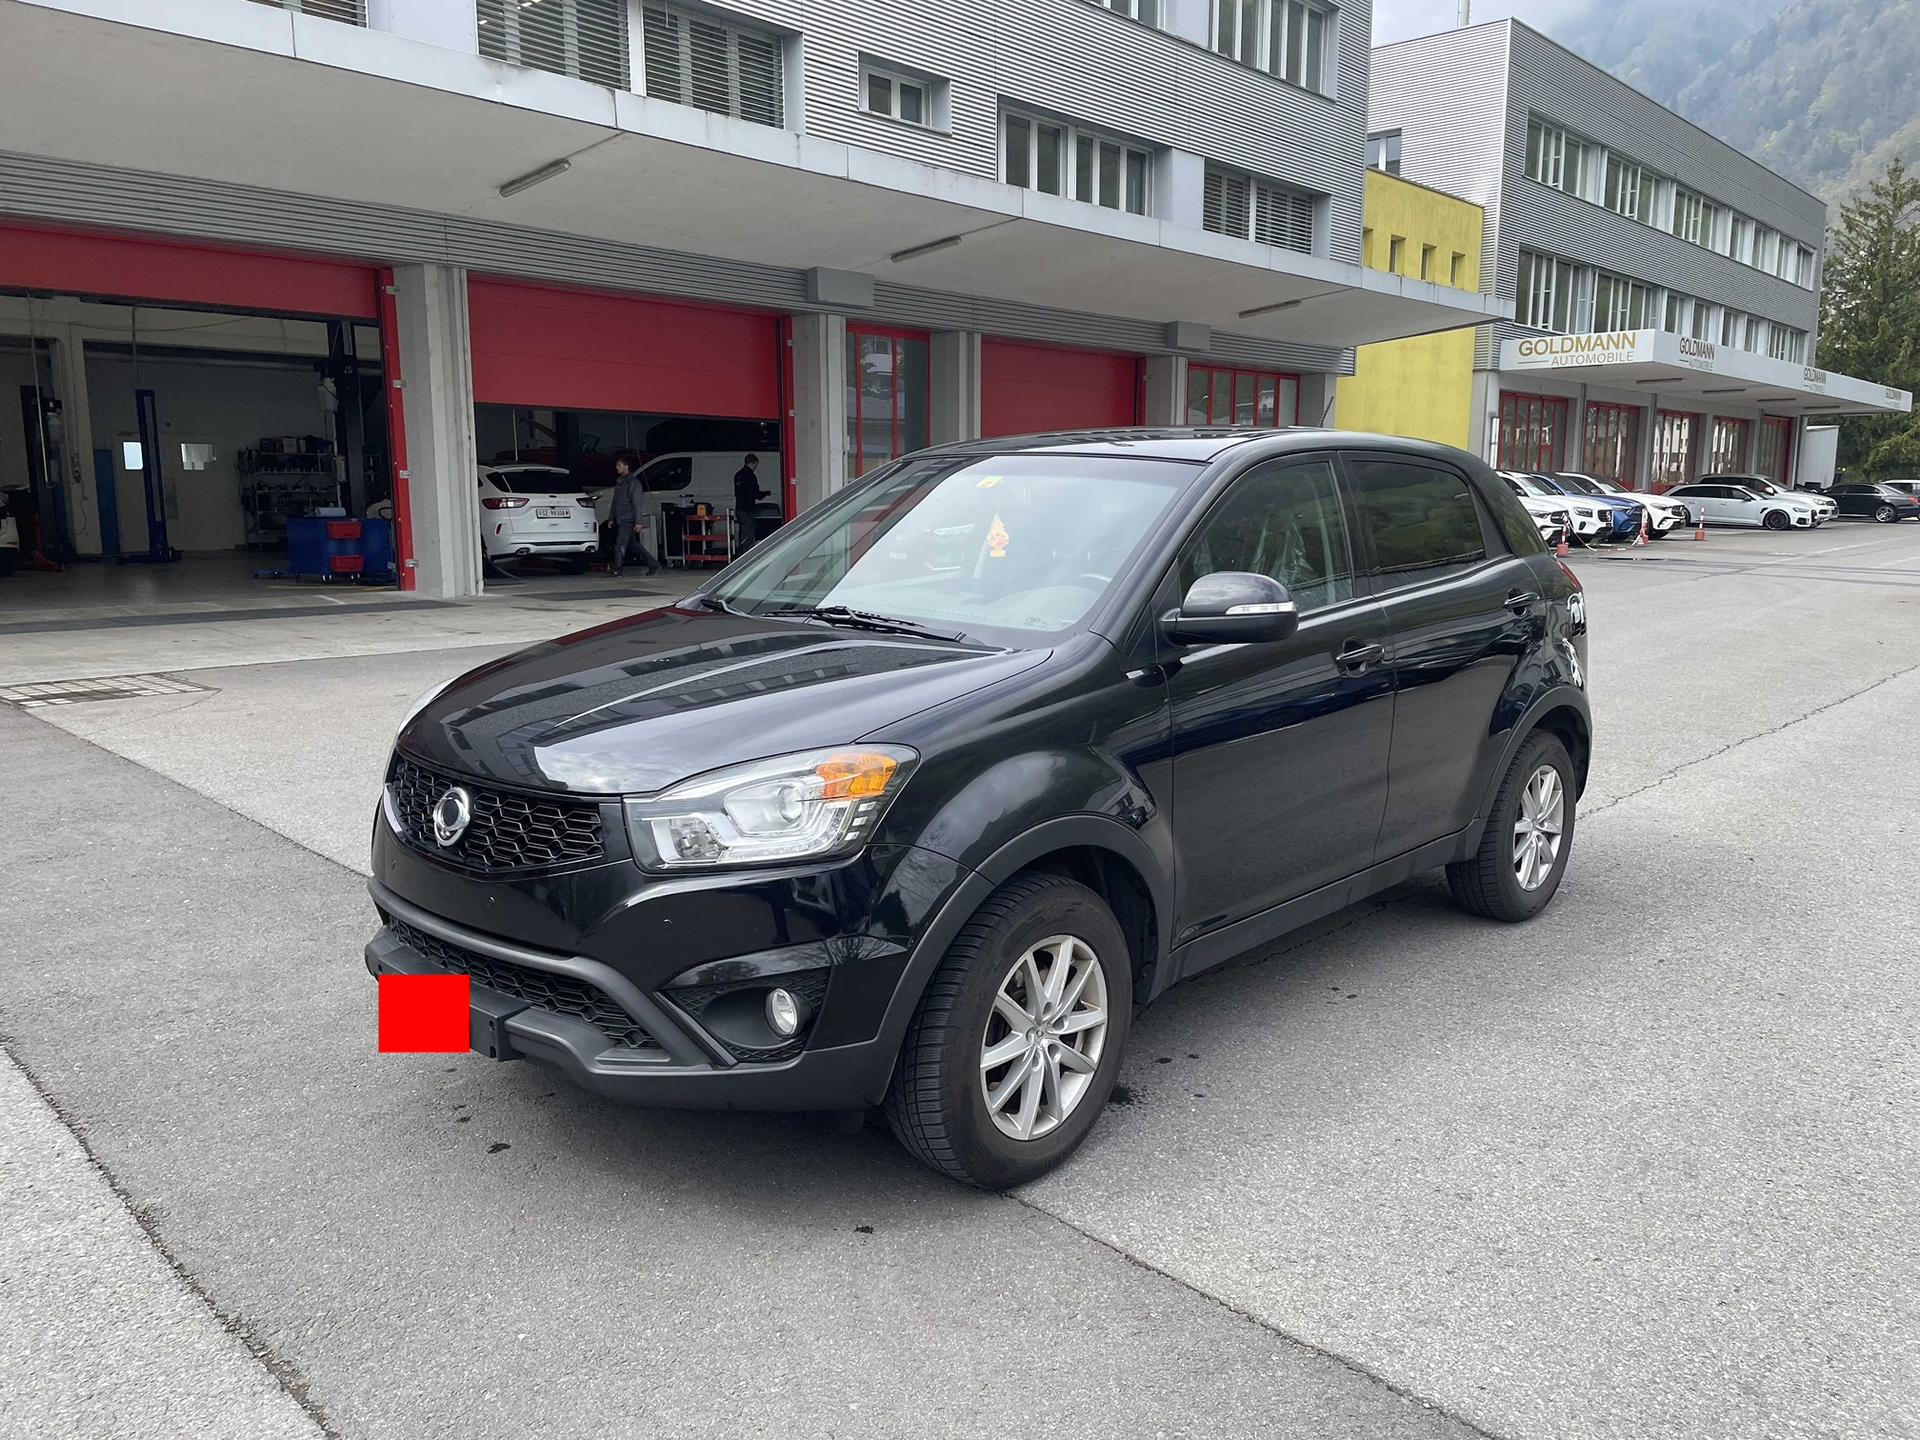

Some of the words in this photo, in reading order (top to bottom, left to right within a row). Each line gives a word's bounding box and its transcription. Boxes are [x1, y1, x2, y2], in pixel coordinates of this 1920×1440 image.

[1518, 332, 1636, 357] GOLDMANN
[1680, 337, 1715, 360] GOLDMANN
[1551, 351, 1634, 367] AUTOMOBILE
[1804, 367, 1826, 384] GOLDMANN
